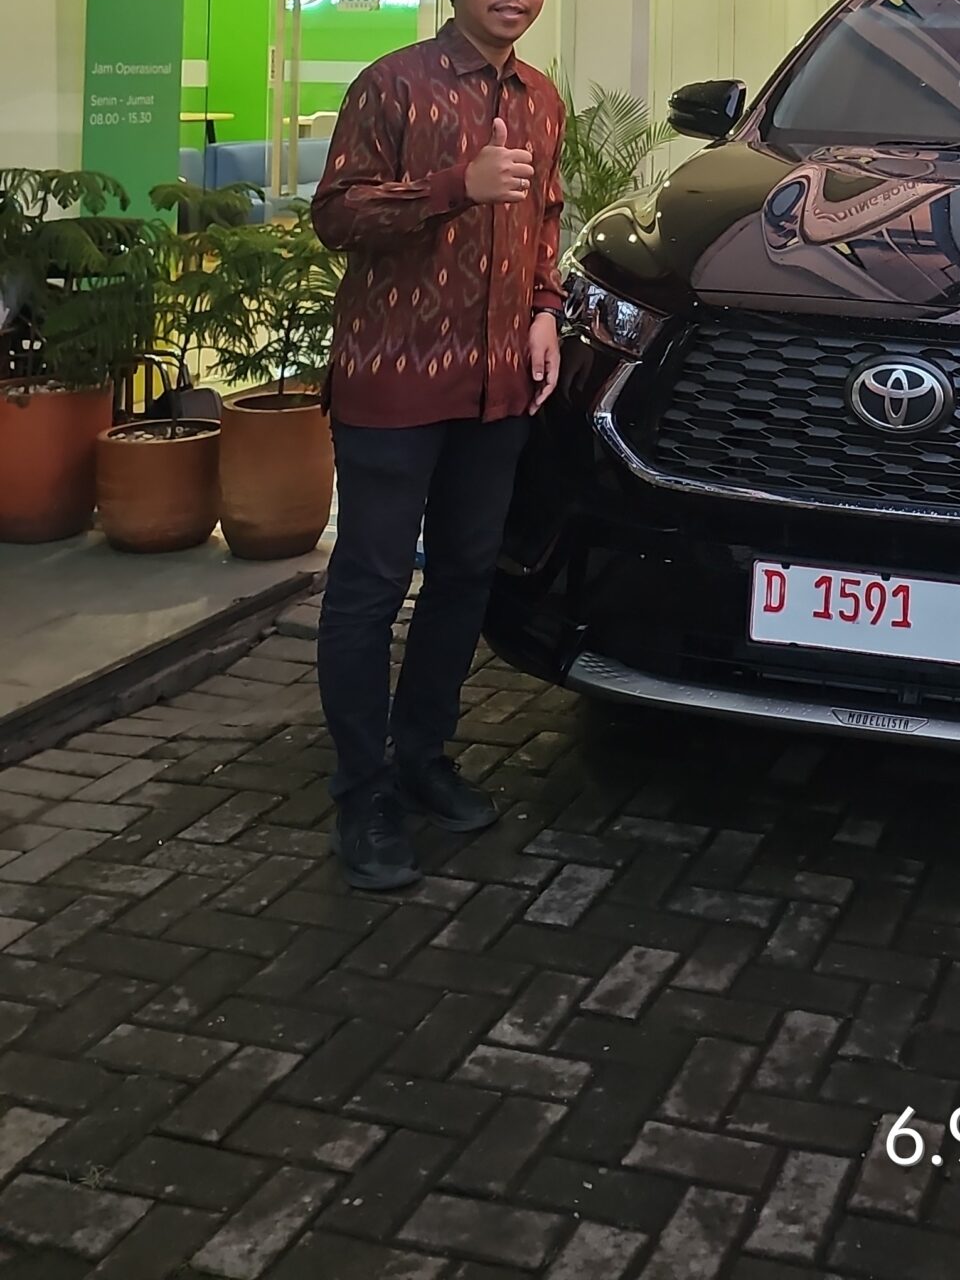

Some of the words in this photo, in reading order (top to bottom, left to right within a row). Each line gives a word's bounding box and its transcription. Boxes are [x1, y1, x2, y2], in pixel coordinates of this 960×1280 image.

[91, 62, 113, 74] Jam
[115, 62, 172, 76] Operasional
[763, 569, 786, 613] D
[812, 575, 912, 629] 1591
[847, 712, 910, 730] MODELLISTA
